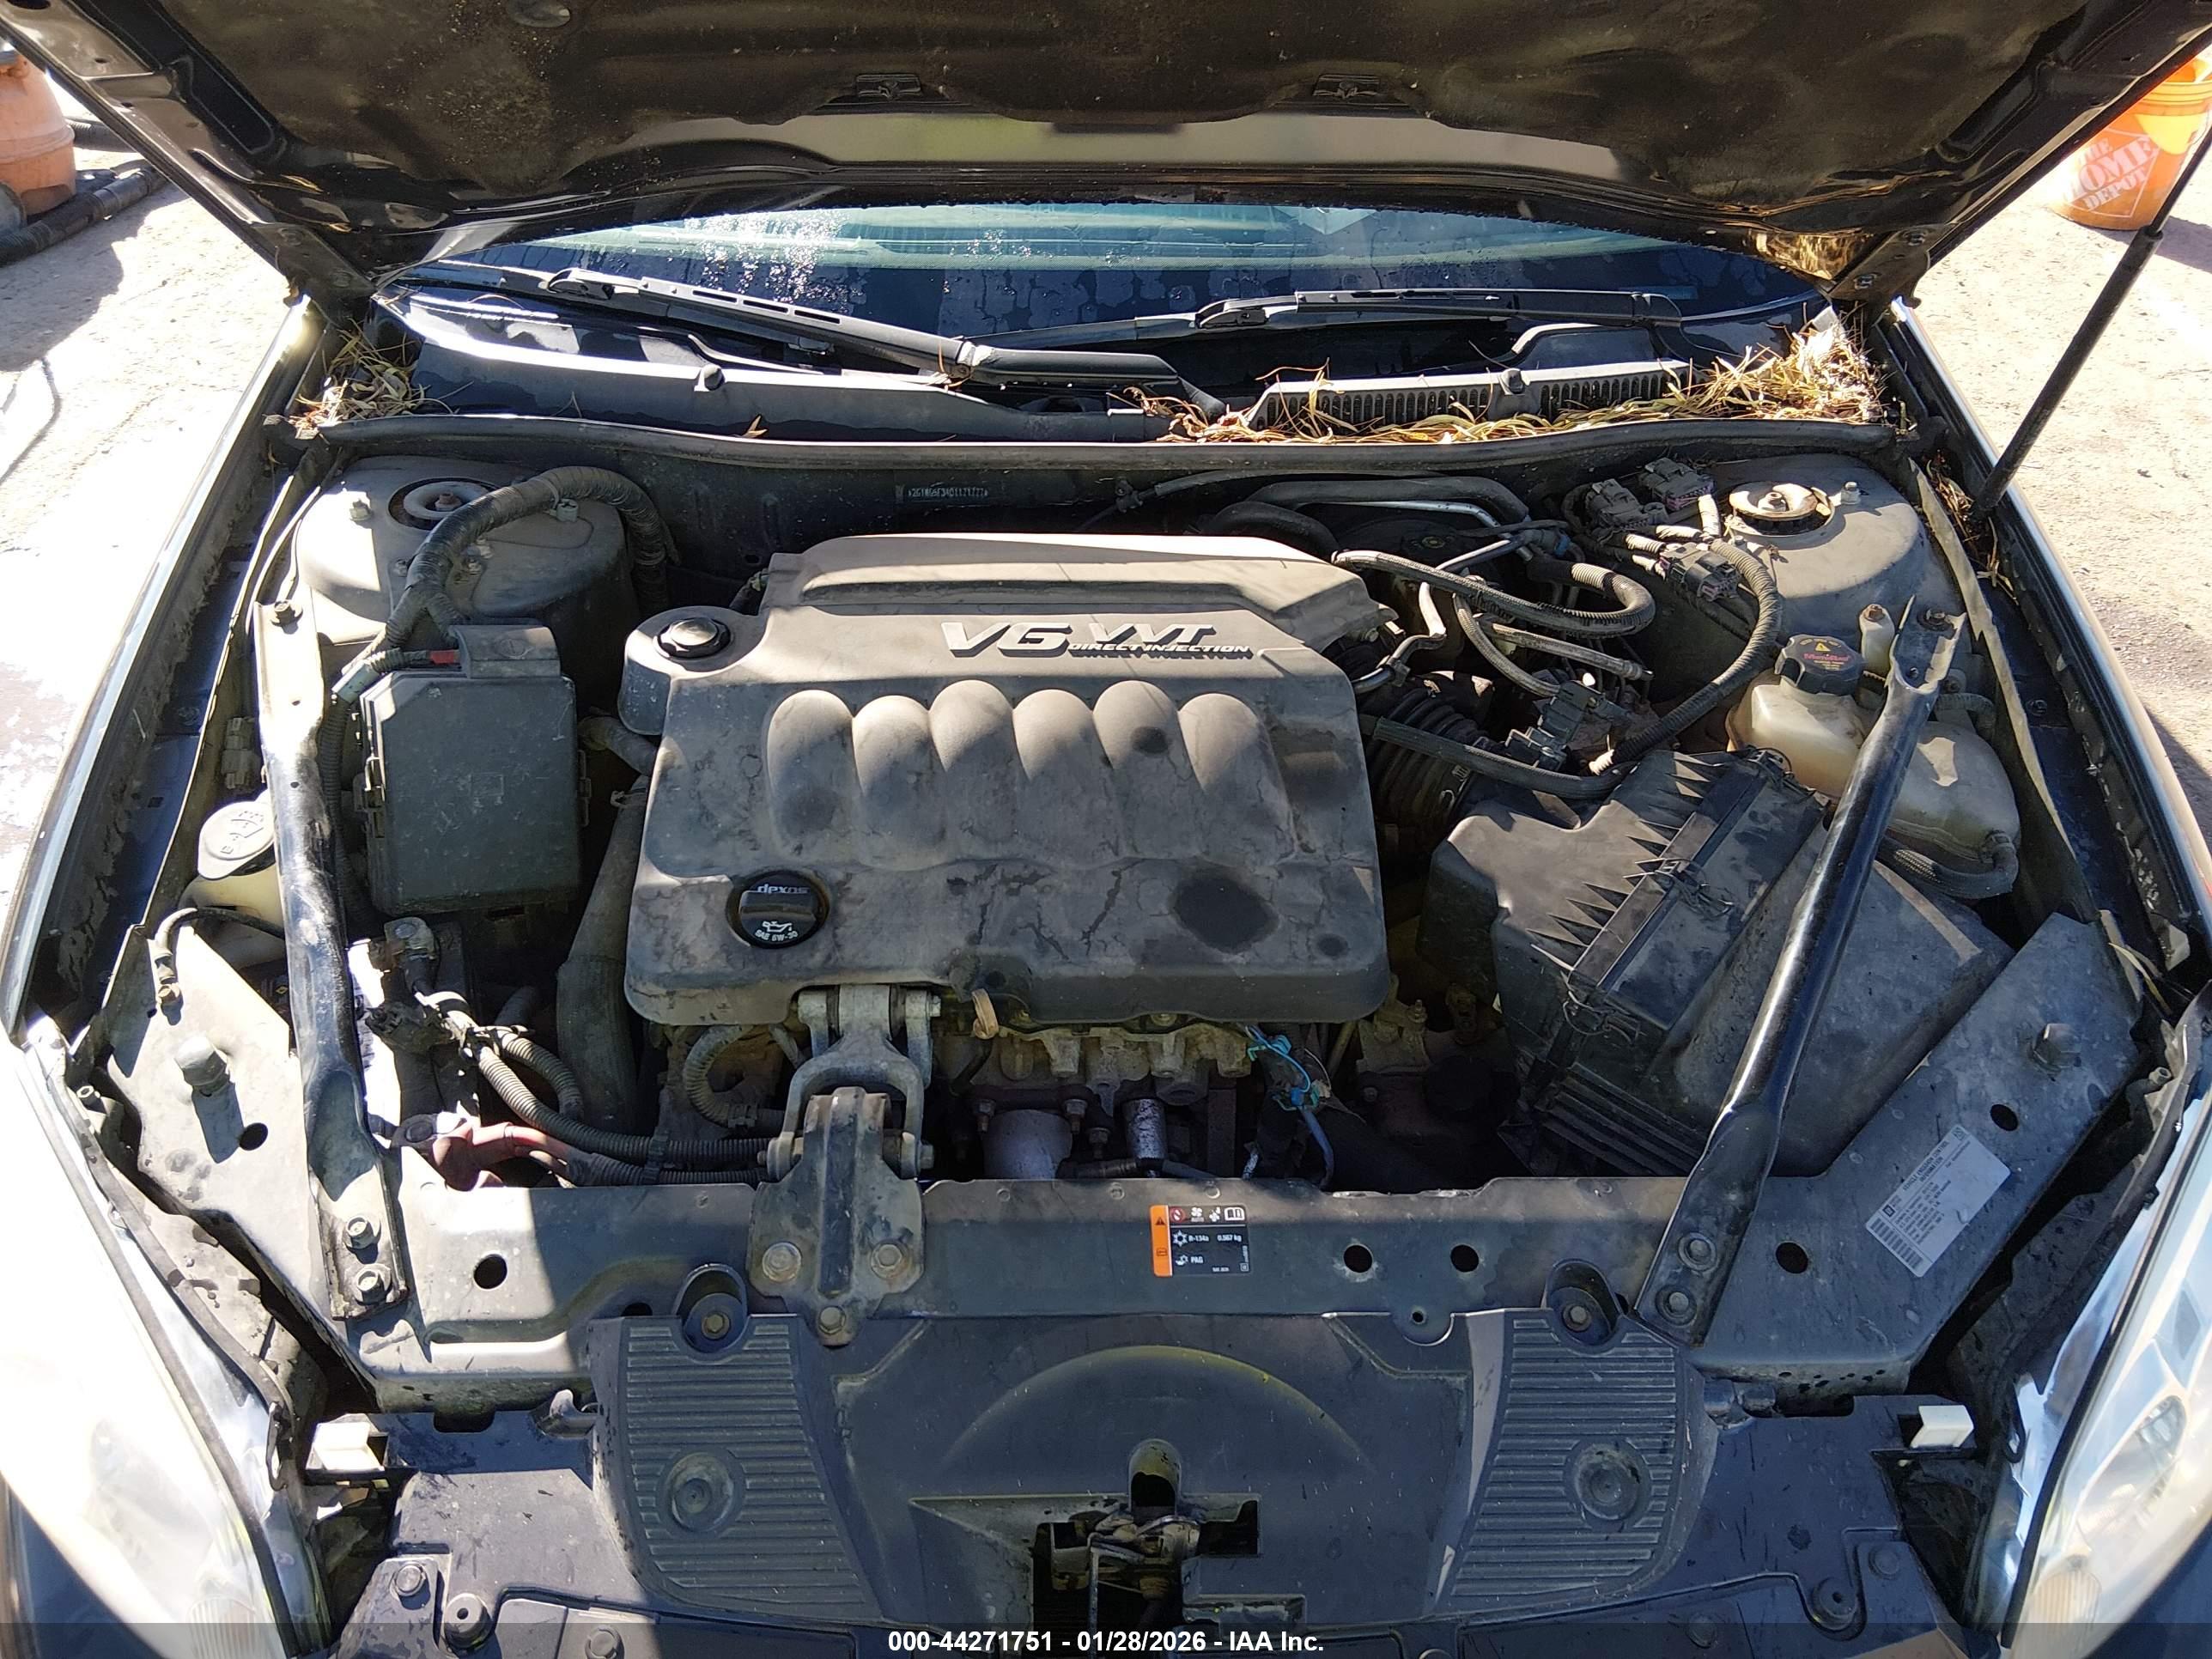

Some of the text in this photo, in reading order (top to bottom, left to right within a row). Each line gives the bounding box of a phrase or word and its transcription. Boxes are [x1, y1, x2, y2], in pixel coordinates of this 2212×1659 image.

[2083, 167, 2148, 210] DEPOT
[941, 622, 1216, 656] V6 VVT
[1067, 644, 1250, 656] DIRECT INJECTION
[757, 884, 811, 894] dexos
[755, 929, 770, 940] SAE
